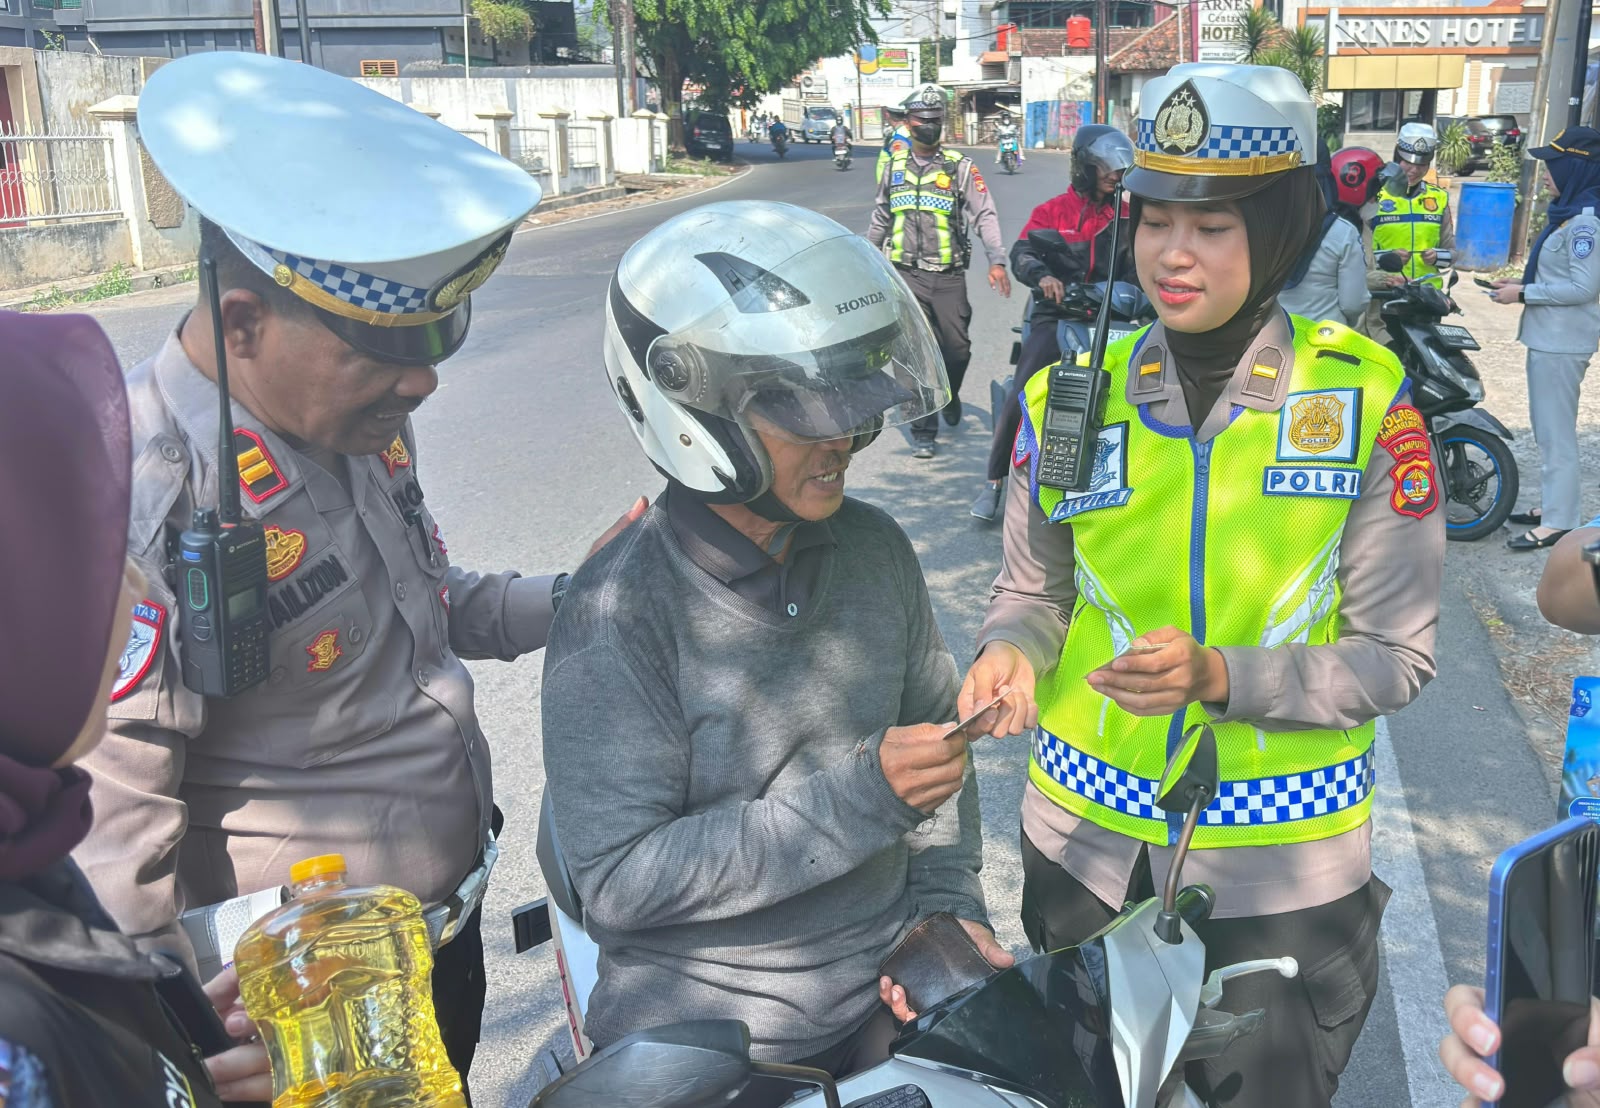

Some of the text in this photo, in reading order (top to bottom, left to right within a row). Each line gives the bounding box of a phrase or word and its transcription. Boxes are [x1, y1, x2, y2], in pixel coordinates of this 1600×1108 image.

[1201, 26, 1243, 41] HOTE
[1441, 17, 1543, 45] HOTEL
[834, 291, 886, 315] HONDA
[1393, 440, 1427, 454] LAMPUNG
[1269, 471, 1357, 493] POLRI
